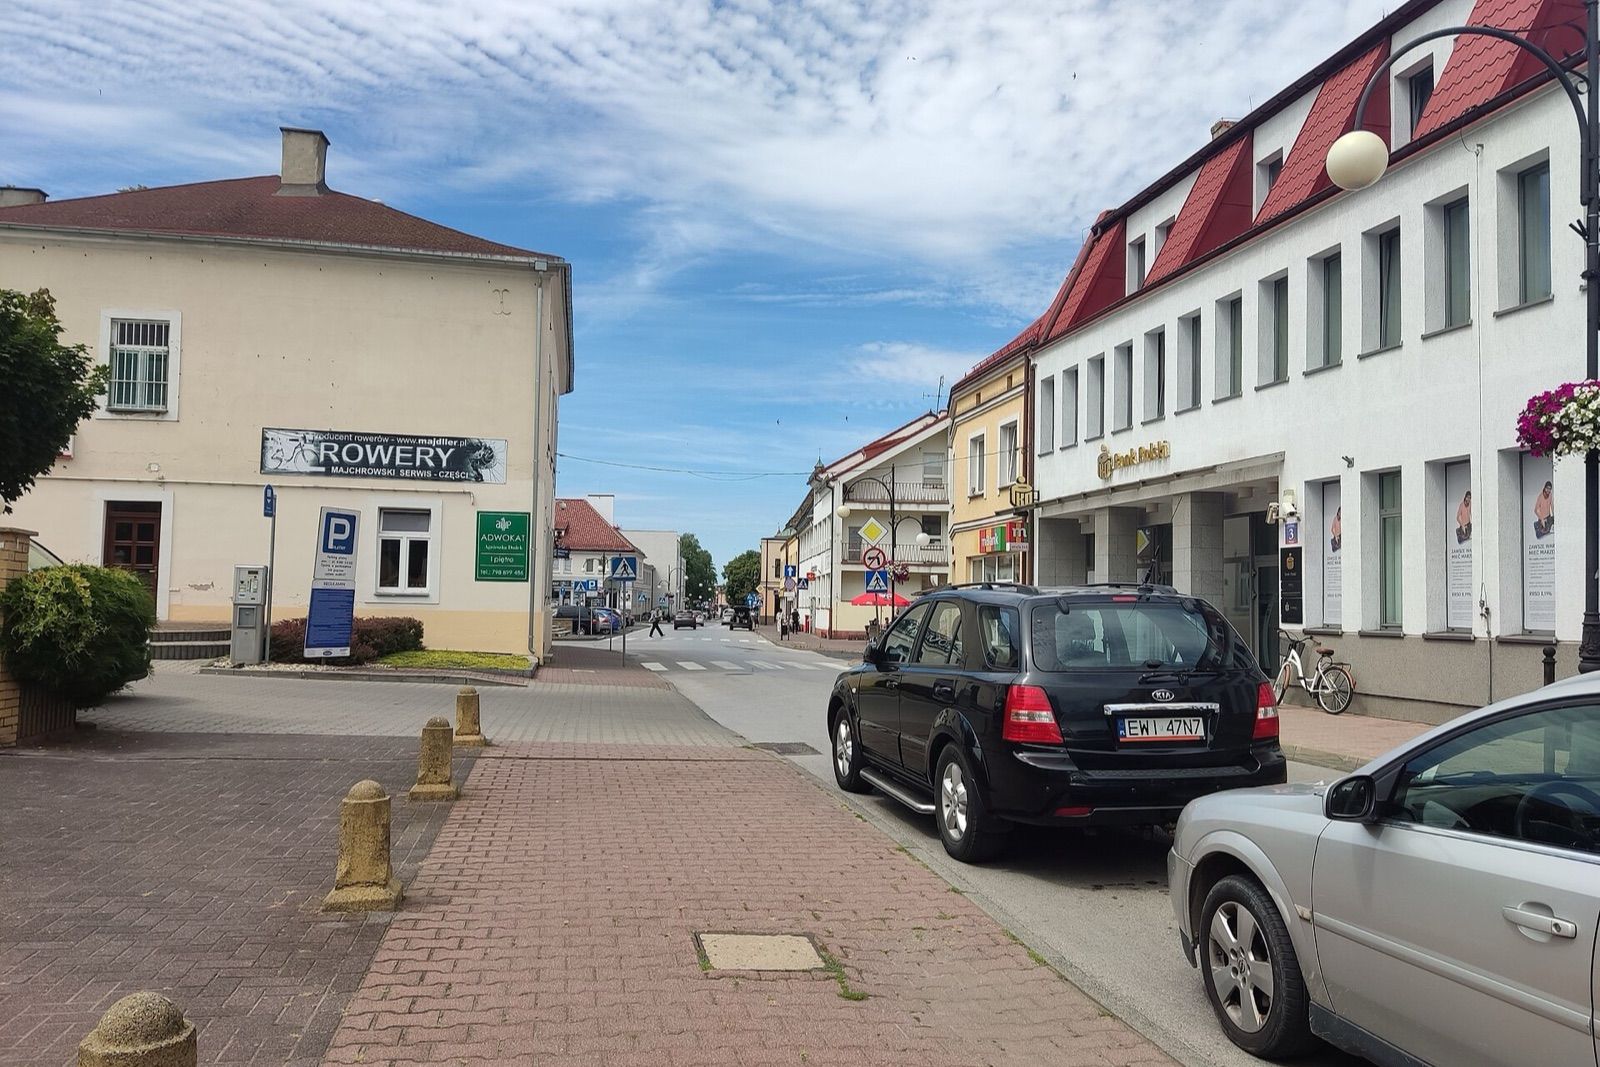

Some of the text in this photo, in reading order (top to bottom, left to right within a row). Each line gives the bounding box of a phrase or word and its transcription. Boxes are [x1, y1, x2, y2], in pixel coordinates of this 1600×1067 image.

[354, 435, 389, 443] rowerów
[320, 442, 455, 468] ROWERY
[331, 466, 396, 476] MAJCHROWSKI
[399, 468, 432, 478] SERWIS
[438, 469, 469, 480] CZĘŚCI
[328, 517, 350, 549] P
[480, 534, 526, 542] ADWOKAT
[1288, 528, 1294, 541] 3
[1156, 692, 1171, 700] KIA
[1128, 719, 1158, 736] EWI
[1166, 719, 1200, 735] 47N7
